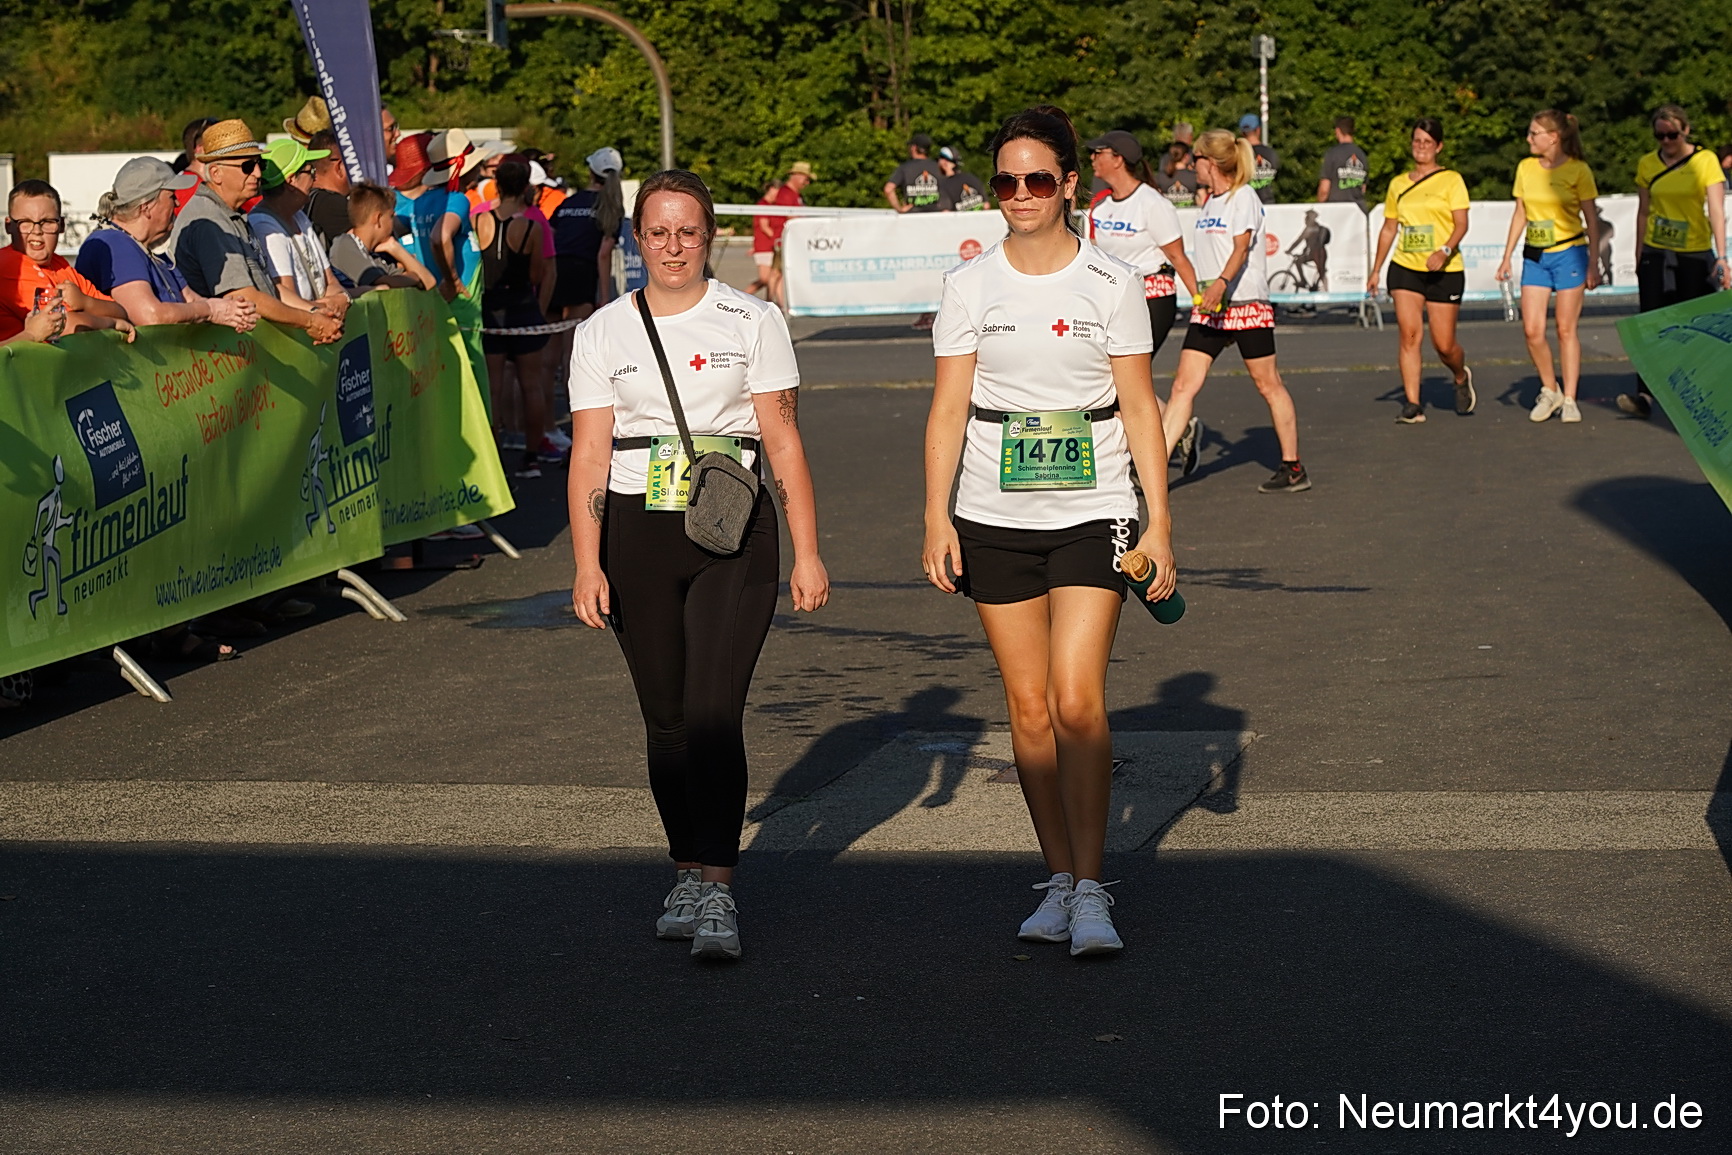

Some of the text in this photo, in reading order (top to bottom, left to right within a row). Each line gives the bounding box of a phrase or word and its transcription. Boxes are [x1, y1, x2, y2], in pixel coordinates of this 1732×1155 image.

[1087, 263, 1113, 281] CRAFT
[716, 302, 745, 316] CRAFT
[981, 322, 1016, 334] Sabrina
[709, 351, 746, 360] Bayerisches
[341, 368, 370, 395] Fischer
[613, 364, 639, 377] Leslie
[86, 420, 123, 449] Fischer
[99, 437, 127, 459] AUTOMOBILE
[1014, 437, 1080, 464] 1478
[1081, 441, 1092, 476] 2022
[1004, 447, 1013, 474] RUN
[1017, 464, 1077, 473] Schimmelpfenning
[652, 464, 663, 500] WALK
[1034, 472, 1060, 480] Sabrina
[70, 453, 189, 574] firmenlauf
[74, 555, 129, 604] neumarkt
